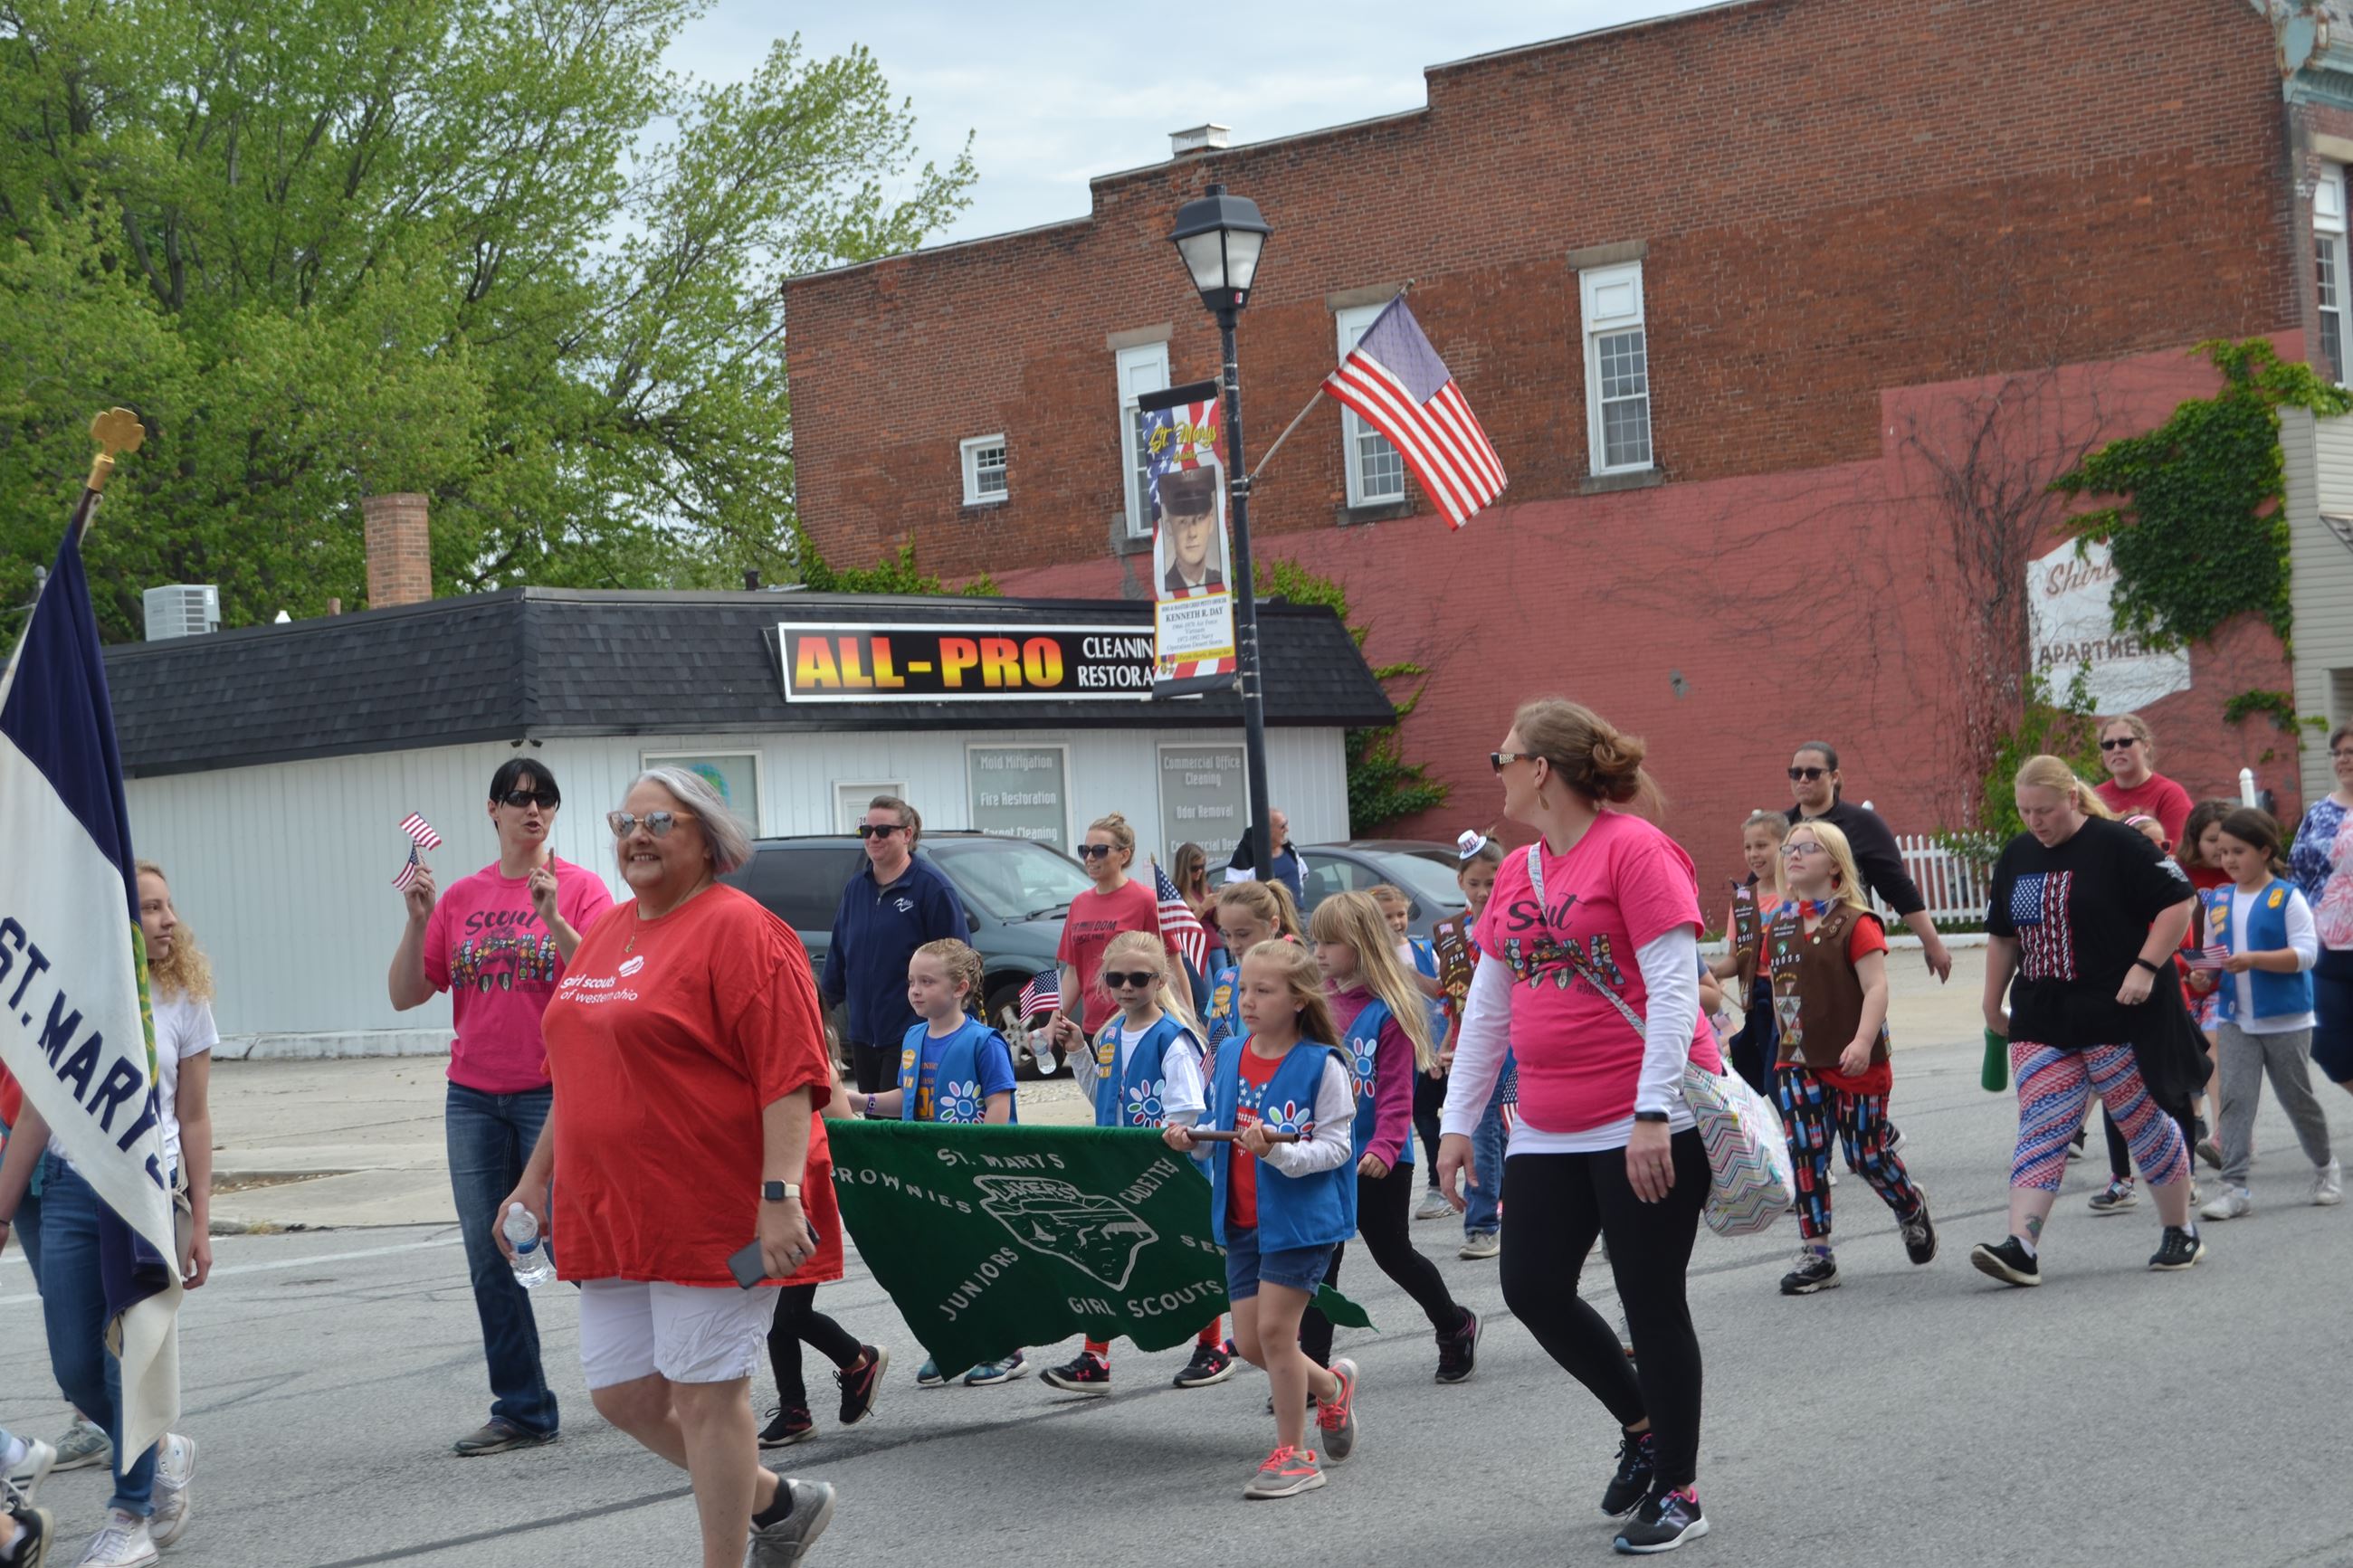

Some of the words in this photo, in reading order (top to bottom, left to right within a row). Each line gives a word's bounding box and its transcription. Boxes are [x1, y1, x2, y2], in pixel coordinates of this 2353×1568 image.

[1166, 609, 1200, 622] KENNETH
[1201, 609, 1208, 617] R.
[1209, 606, 1224, 615] DAY
[1082, 637, 1154, 659] CLEANIN
[795, 636, 1064, 689] ALL-PRO
[1077, 665, 1155, 687] RESTORA
[980, 755, 1004, 769] Mold
[1005, 755, 1053, 771] Mitigation
[1164, 755, 1214, 769] Commercial
[1215, 755, 1241, 770] Office
[1186, 772, 1222, 787] Cleaning
[980, 793, 1000, 806] Fire
[1002, 790, 1057, 805] Restoration
[1176, 805, 1196, 819] Odor
[1197, 804, 1234, 818] Removal
[560, 974, 586, 989] girl
[582, 975, 616, 989] scouts
[560, 988, 577, 1000] of
[614, 987, 638, 1002] ohio
[937, 1148, 976, 1166] ST.
[979, 1154, 1064, 1169] MARYS
[938, 1246, 1019, 1322] JUNIORS
[1067, 1297, 1117, 1316] GIRL
[1127, 1279, 1224, 1318] SCOUTS
